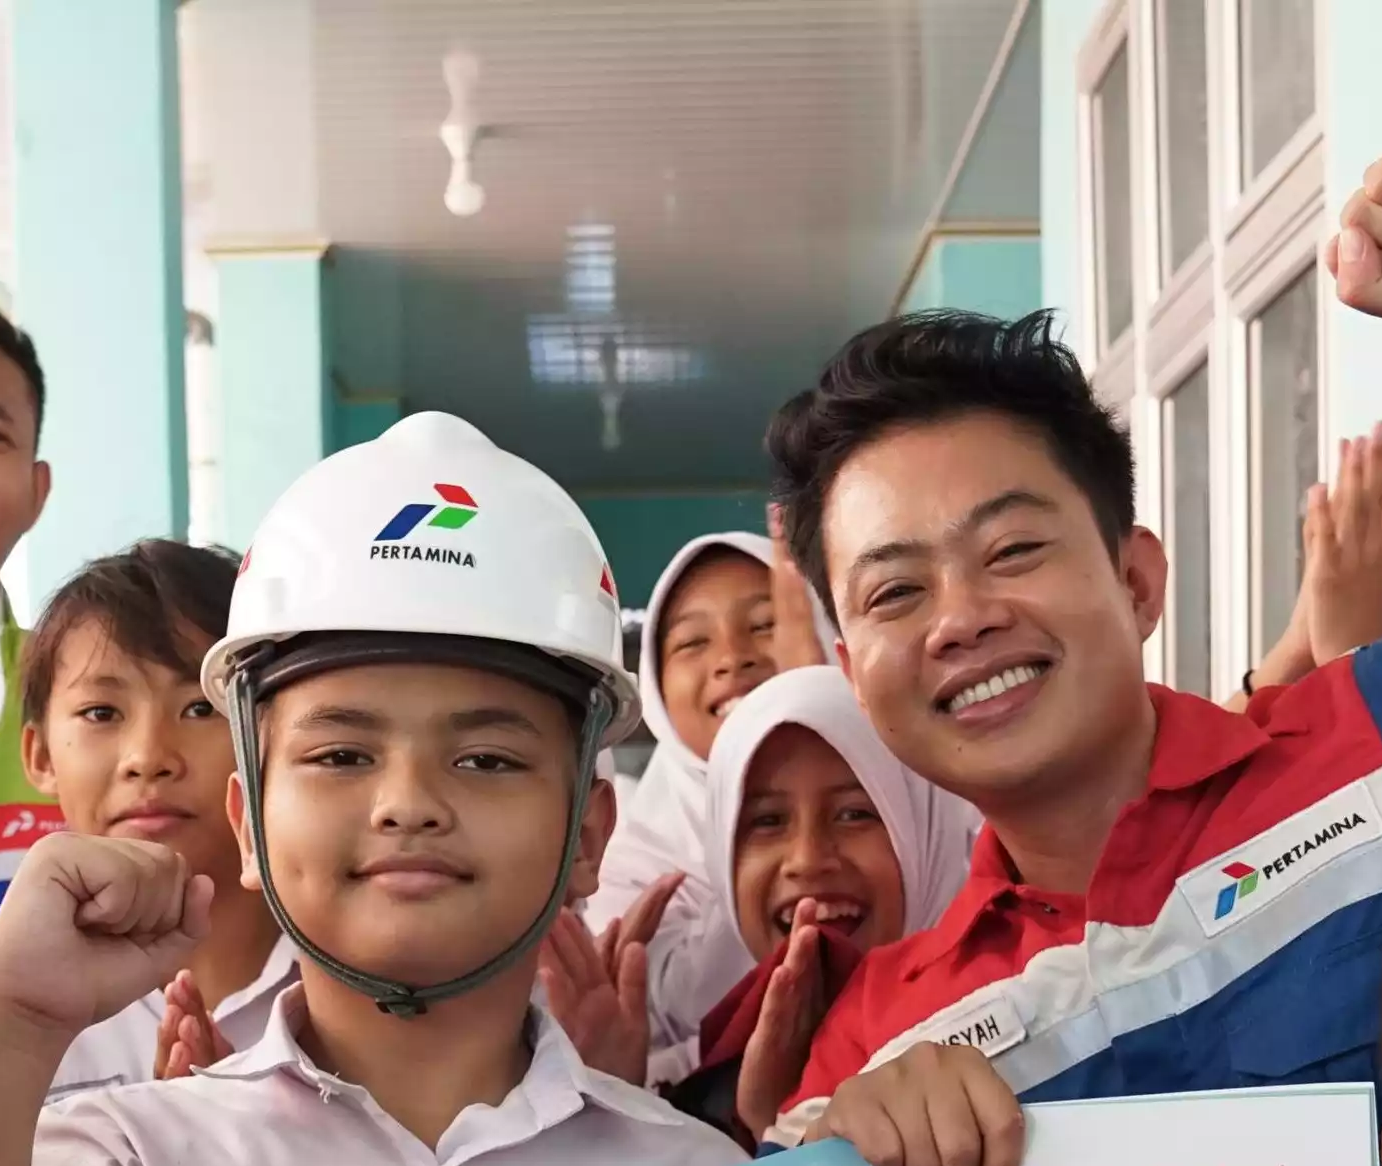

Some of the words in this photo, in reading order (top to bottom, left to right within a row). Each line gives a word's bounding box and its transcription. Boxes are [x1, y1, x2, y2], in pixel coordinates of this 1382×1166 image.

[370, 545, 477, 568] PERTAMINA
[1262, 812, 1366, 879] PERTAMINA
[943, 1014, 1001, 1046] SYAH
